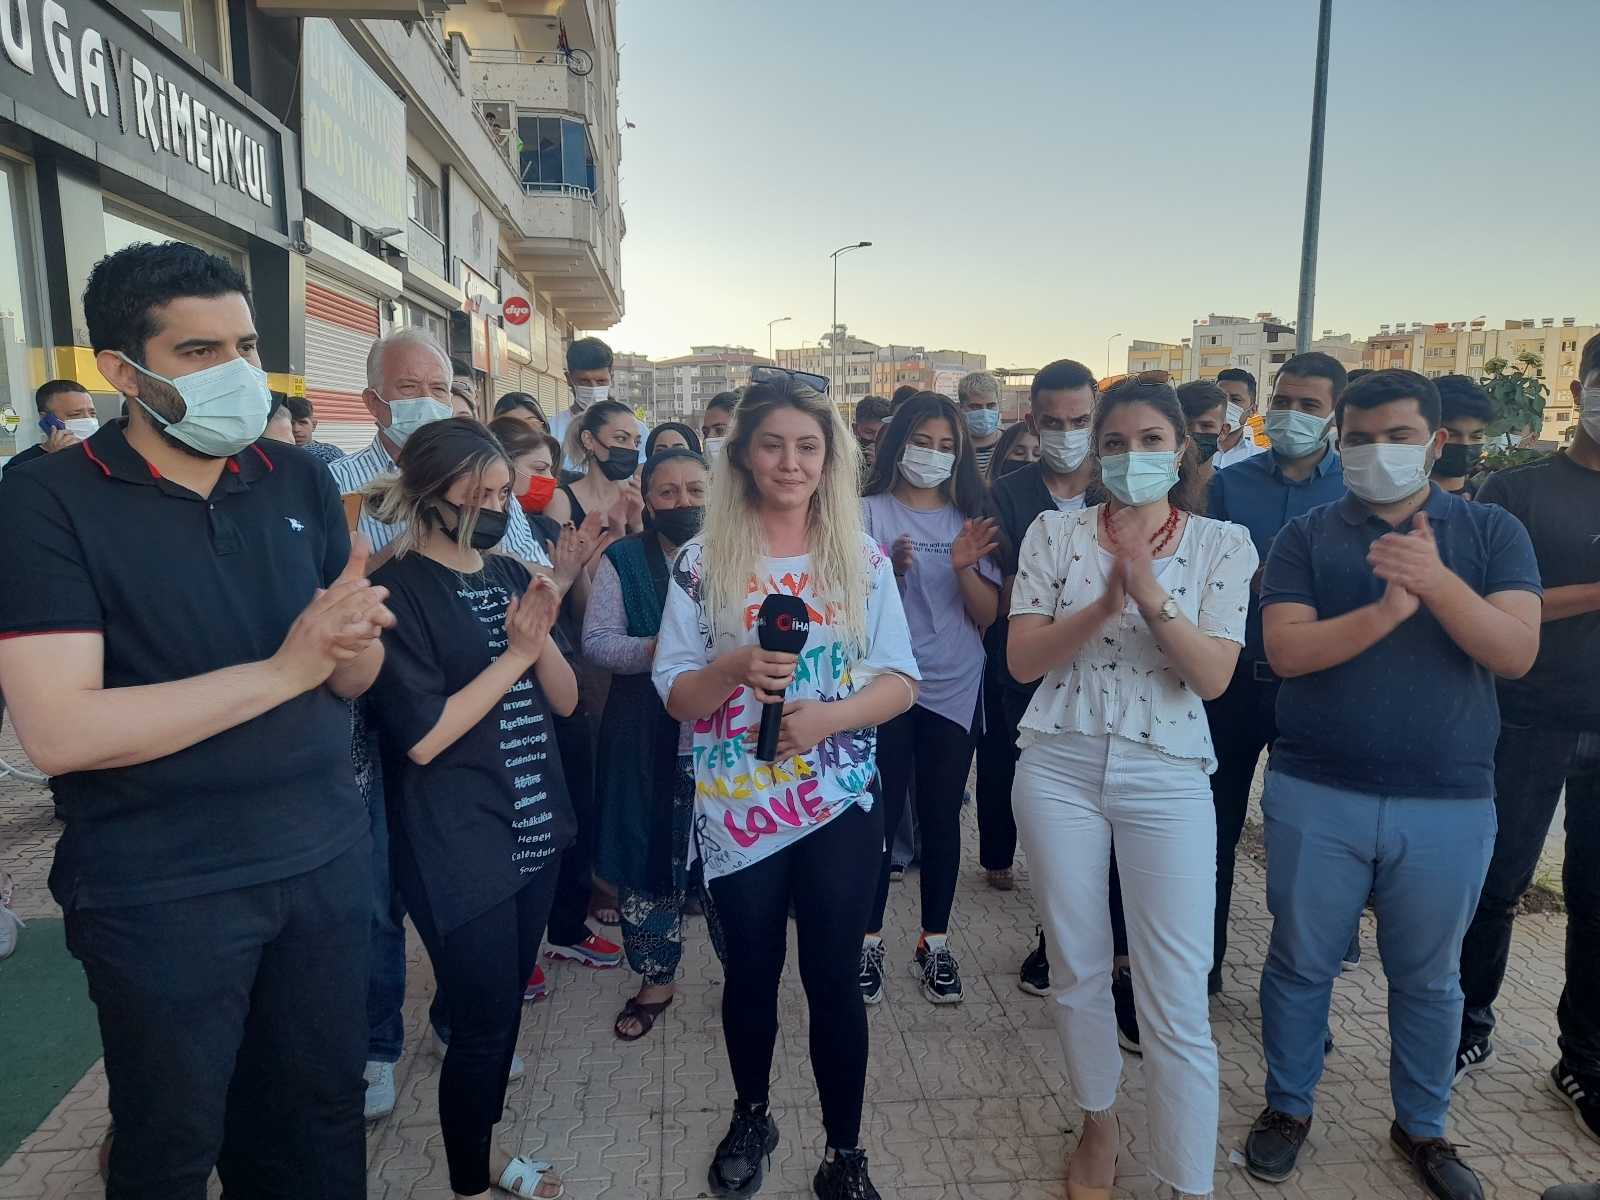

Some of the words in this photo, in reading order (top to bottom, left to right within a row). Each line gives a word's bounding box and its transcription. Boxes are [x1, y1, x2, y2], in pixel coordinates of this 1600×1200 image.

[310, 20, 357, 122] BLACK
[359, 78, 391, 154] AUTO
[308, 100, 345, 177] OTO
[348, 134, 403, 222] YIKAMA
[504, 304, 529, 317] dyo
[723, 780, 824, 848] LOVE
